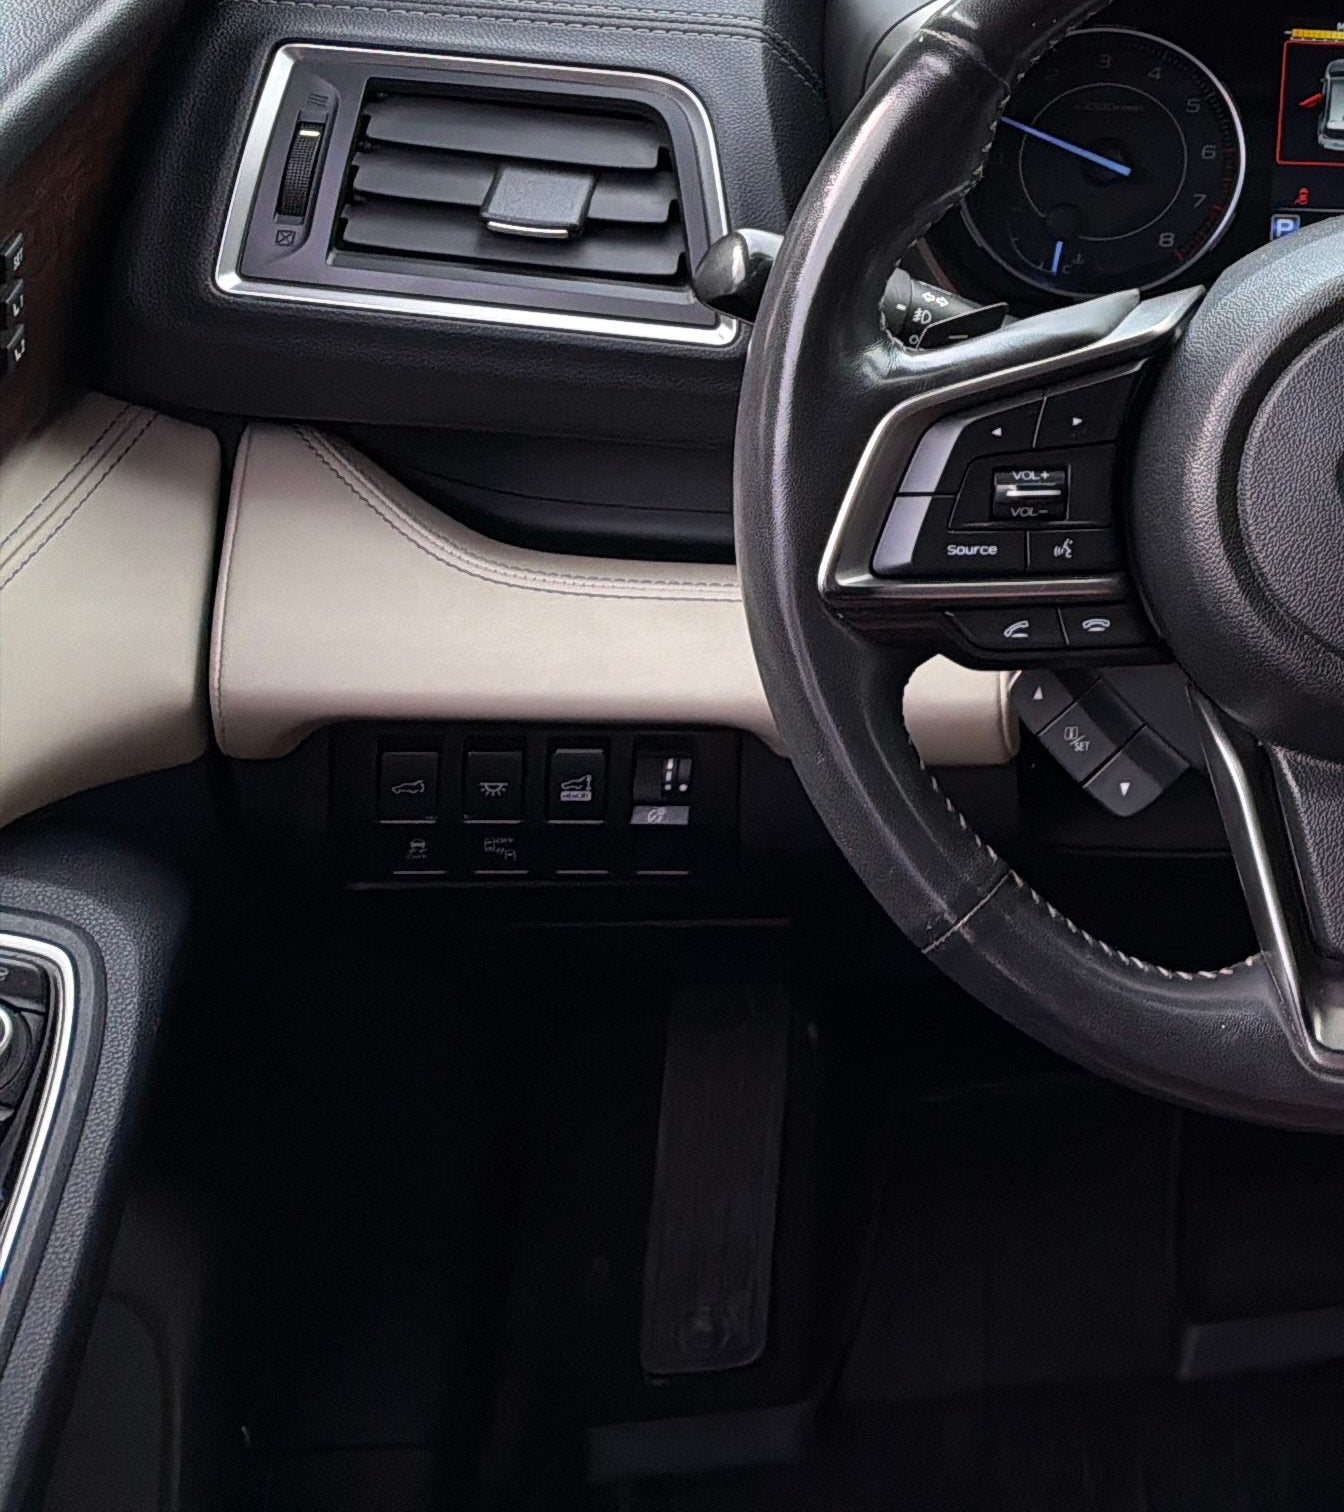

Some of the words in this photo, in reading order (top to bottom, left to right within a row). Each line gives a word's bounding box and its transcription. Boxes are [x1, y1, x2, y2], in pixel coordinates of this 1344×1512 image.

[1147, 67, 1163, 80] 4
[1186, 98, 1200, 113] 5
[1201, 144, 1217, 160] 6
[1192, 193, 1207, 208] 7
[1276, 219, 1293, 238] P
[1158, 232, 1175, 247] 8
[946, 543, 998, 557] Source
